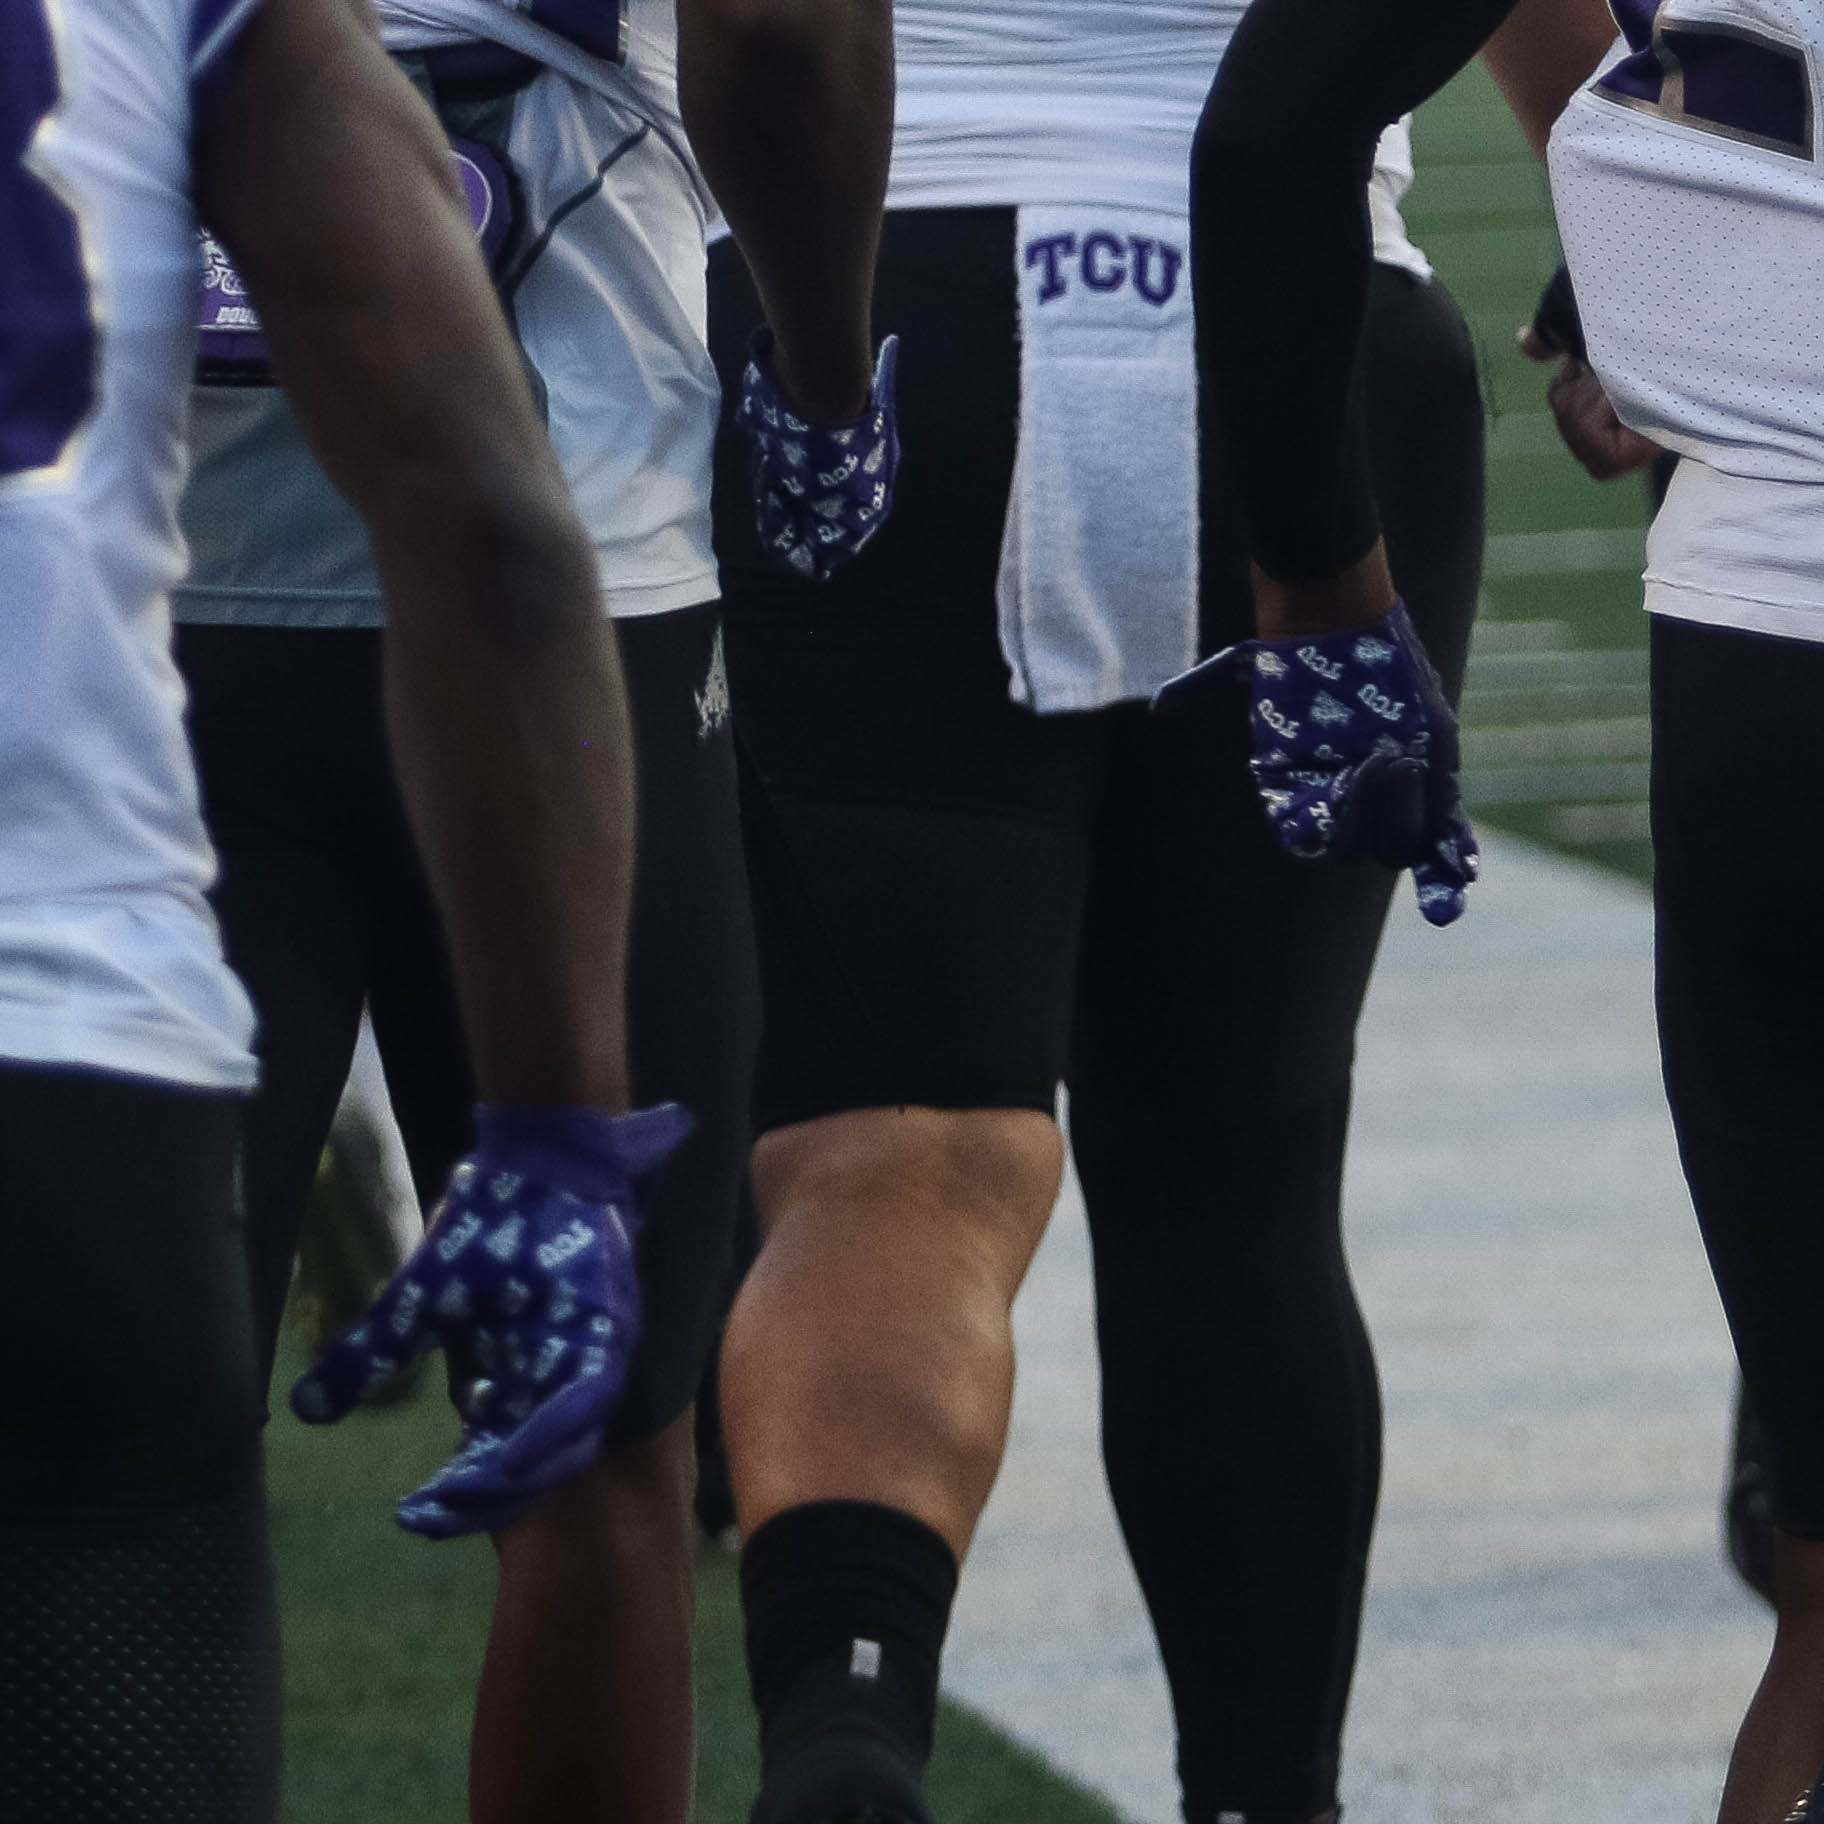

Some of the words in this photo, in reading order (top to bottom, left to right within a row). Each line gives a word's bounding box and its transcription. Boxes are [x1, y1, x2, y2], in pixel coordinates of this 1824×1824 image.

[1025, 230, 1182, 307] TCU
[1257, 698, 1300, 739] TCU
[1357, 683, 1406, 722] TCU
